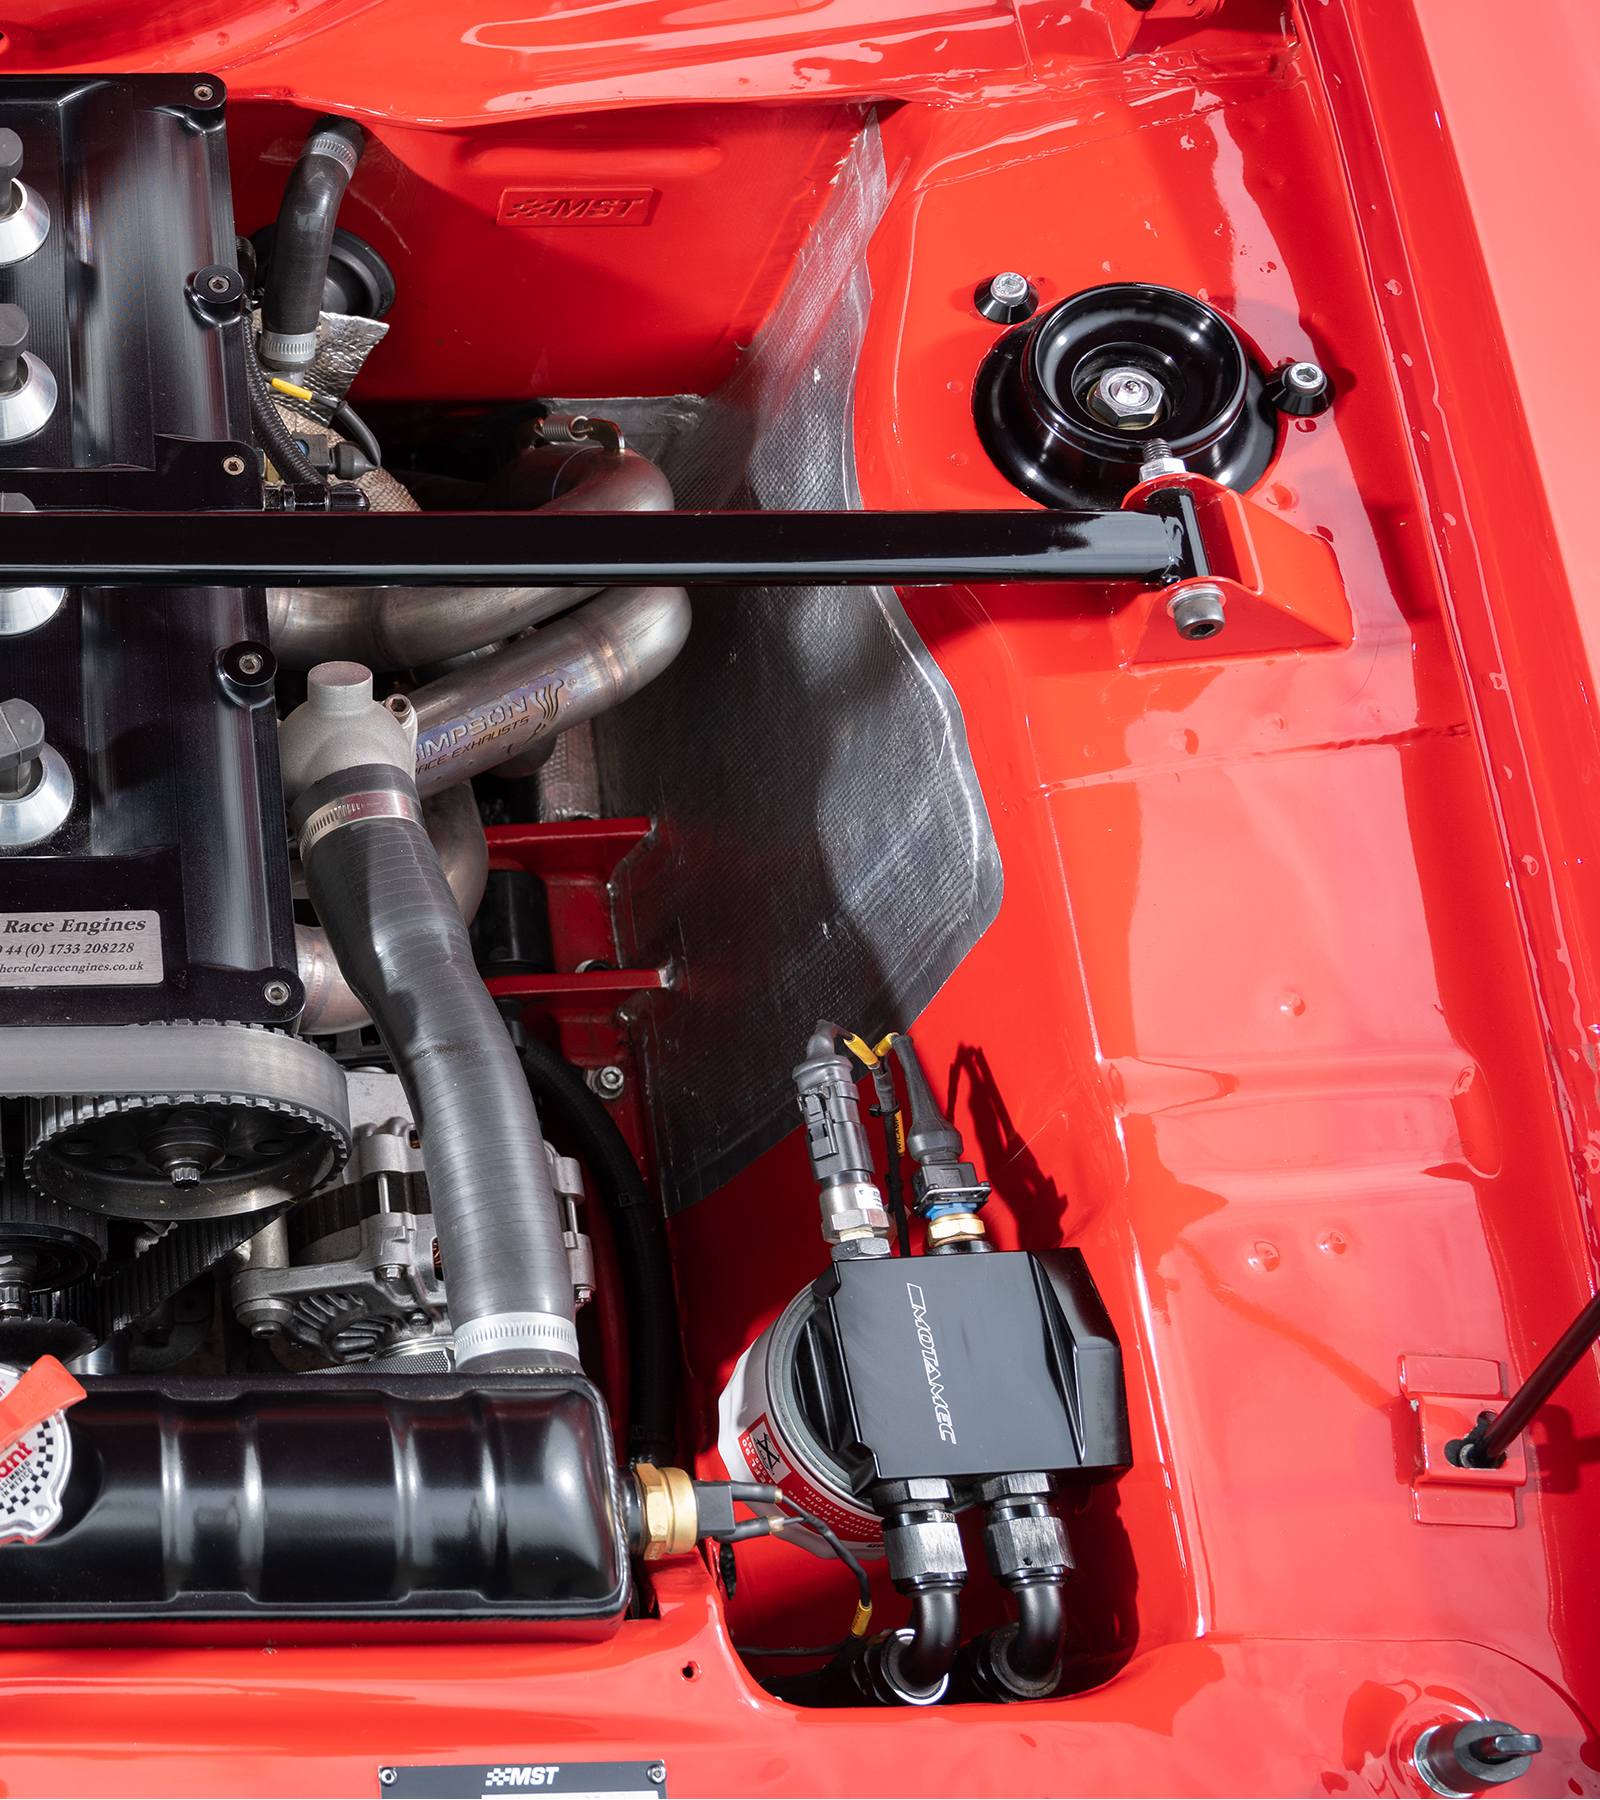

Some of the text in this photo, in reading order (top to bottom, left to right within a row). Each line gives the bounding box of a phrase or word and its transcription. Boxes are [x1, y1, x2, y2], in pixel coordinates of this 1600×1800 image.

[549, 198, 644, 218] MST
[415, 695, 528, 763] IMPSON
[415, 715, 530, 776] ACE EXHAUSTS
[3, 919, 54, 933] Race
[59, 917, 147, 936] Engines
[5, 944, 22, 955] 44
[25, 943, 45, 957] (0)
[48, 943, 80, 955] 1733
[84, 942, 135, 954] 208228
[911, 1304, 957, 1445] MOTAMEC
[1, 1468, 34, 1499] IN MEXICO
[509, 1766, 559, 1786] MST
